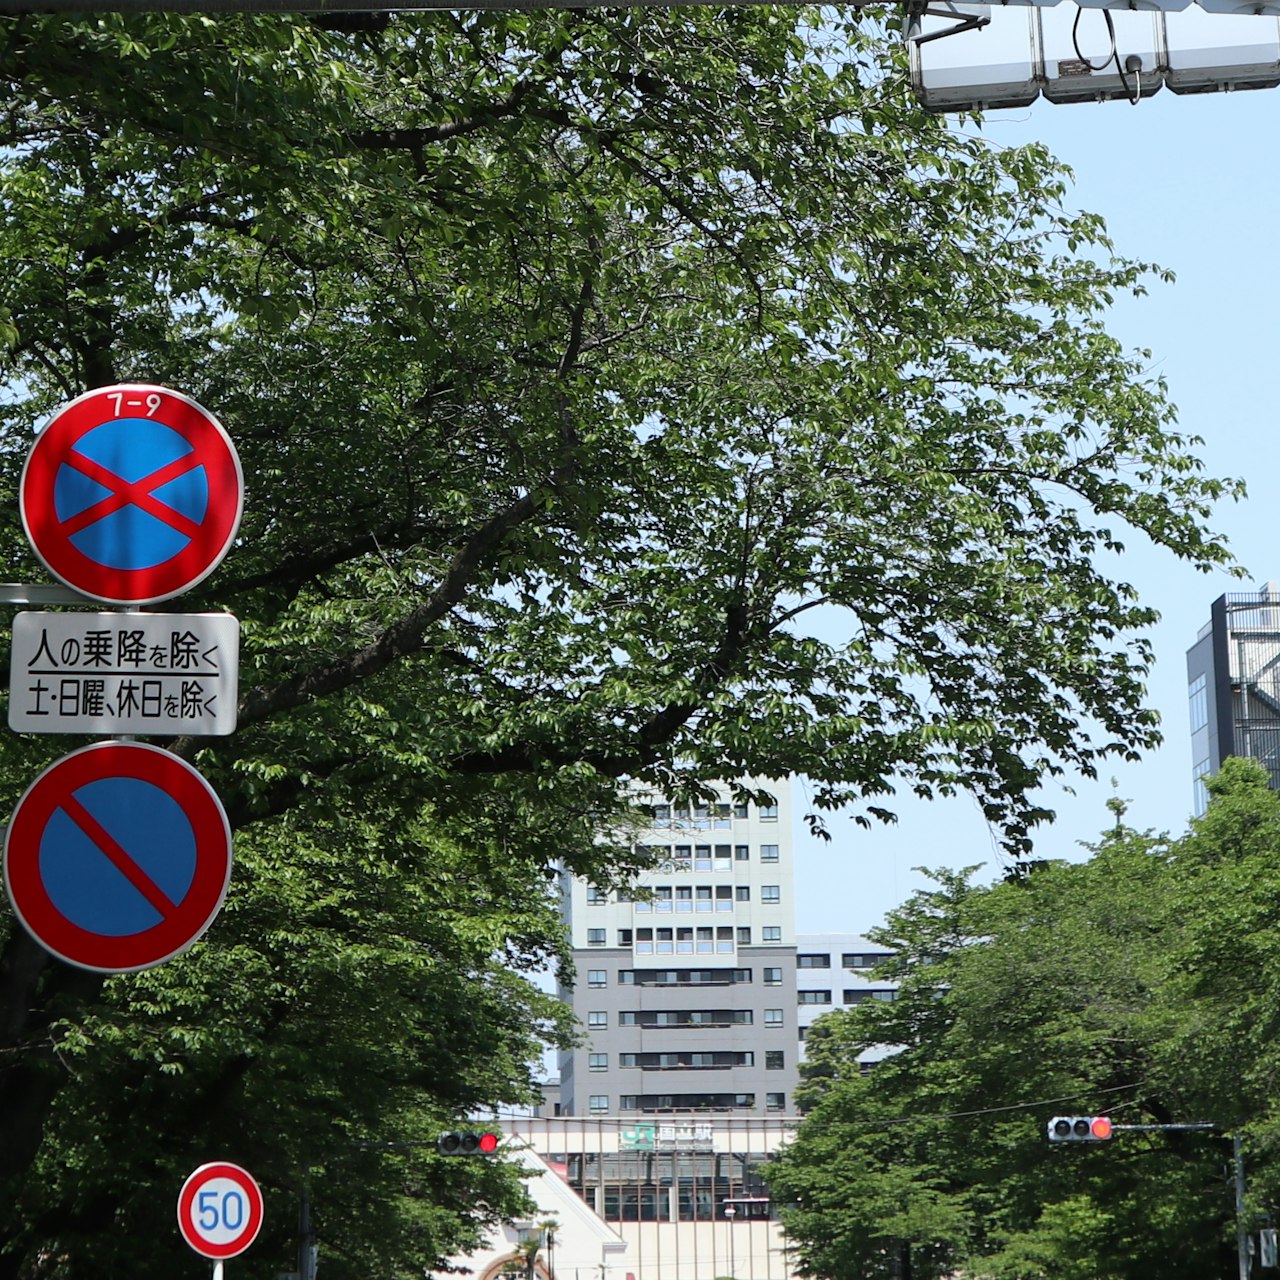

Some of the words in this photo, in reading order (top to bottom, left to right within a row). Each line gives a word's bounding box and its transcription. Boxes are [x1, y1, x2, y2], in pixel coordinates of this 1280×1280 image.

[107, 392, 161, 417] 7-9
[27, 628, 219, 669] 人の乗降を除く
[623, 1122, 656, 1142] JR
[198, 1191, 243, 1231] 50
